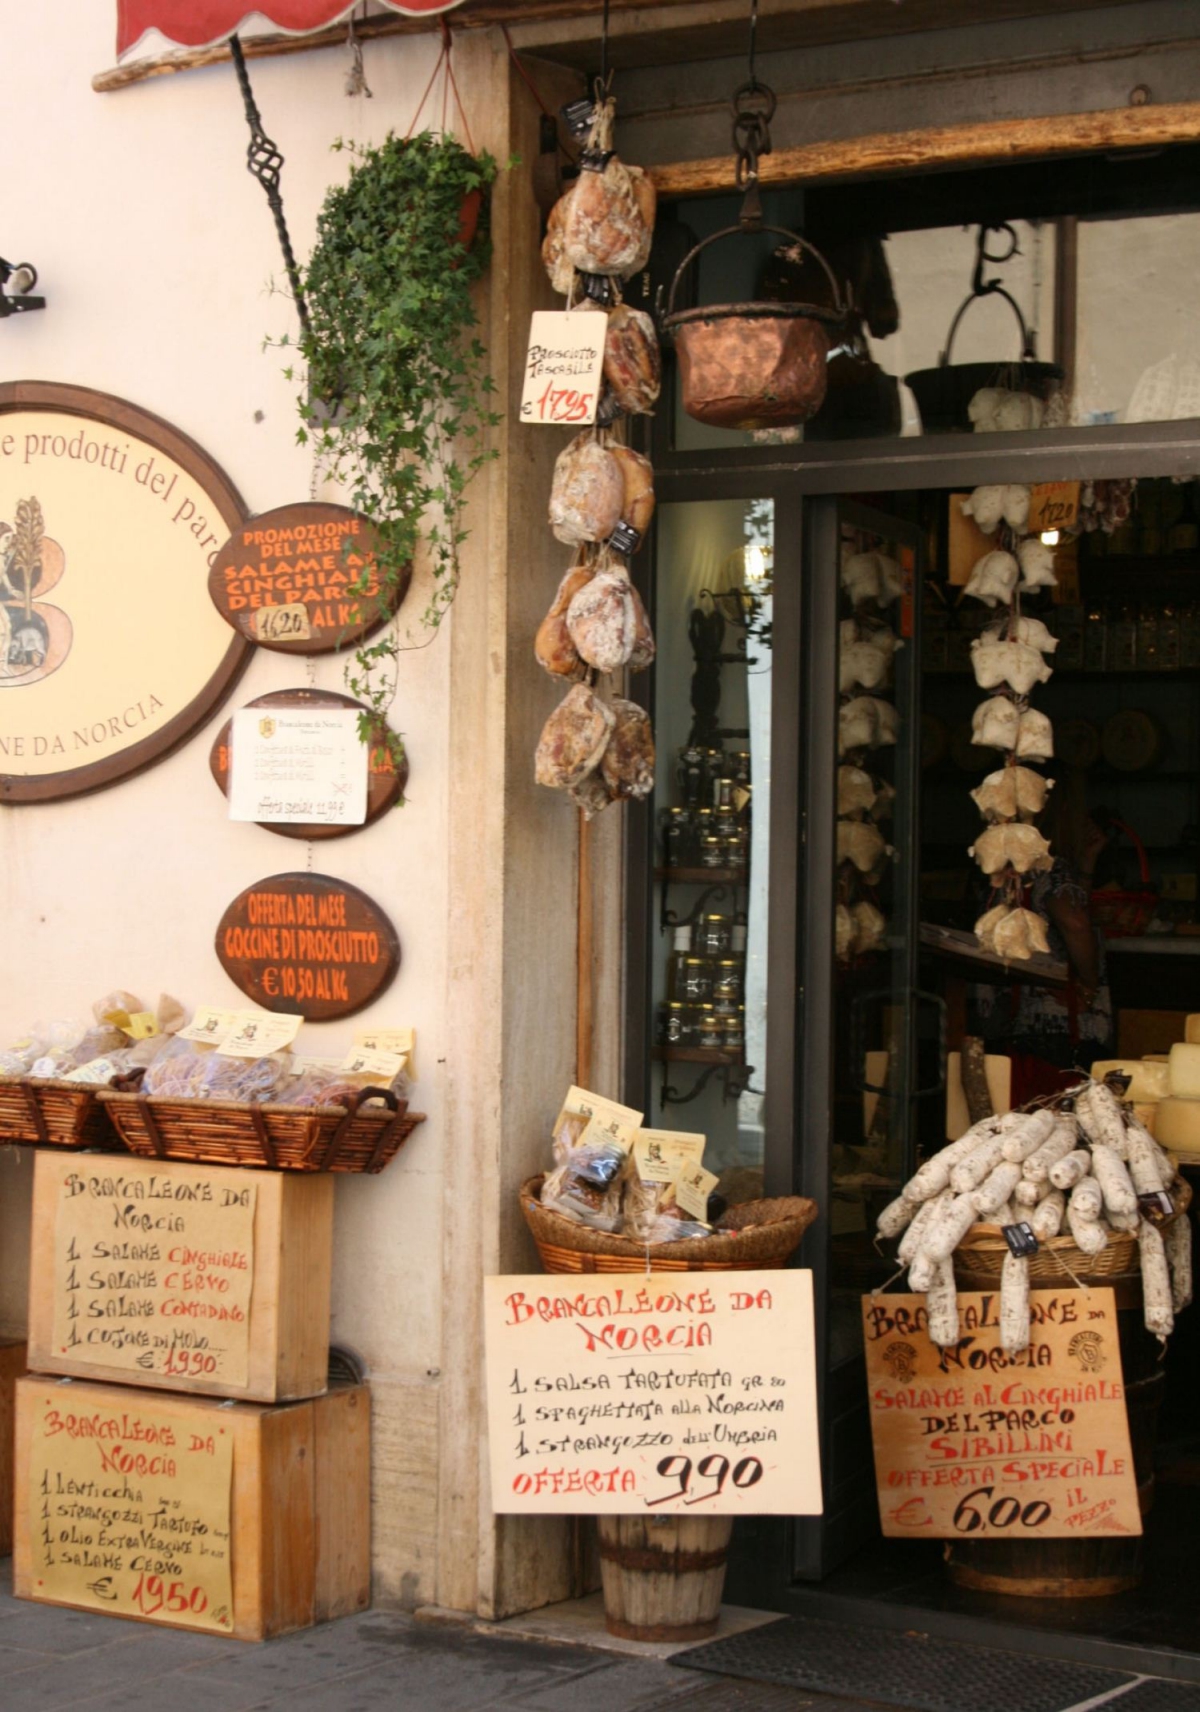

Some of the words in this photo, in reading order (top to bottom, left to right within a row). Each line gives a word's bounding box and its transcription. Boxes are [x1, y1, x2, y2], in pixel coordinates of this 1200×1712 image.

[23, 430, 130, 474] prodotti
[134, 457, 178, 502] del
[243, 519, 360, 546] PROMOZIONE
[261, 543, 293, 559] DEL
[296, 536, 341, 555] MESE
[224, 555, 336, 580] SALAME
[228, 592, 278, 611] DEL
[312, 605, 335, 628] AL
[34, 735, 66, 756] DA
[72, 694, 164, 750] NORCIA
[248, 893, 295, 925] OFFERTA
[296, 894, 317, 926] DEL
[318, 894, 347, 927] MESE
[281, 929, 296, 960] DI
[299, 930, 378, 964] PROSCIUTTO
[316, 970, 331, 1000] AL
[332, 969, 348, 1001] KG
[64, 1174, 213, 1201] BRANCALEONE
[220, 1188, 250, 1208] DA
[113, 1203, 185, 1232] NORCIA
[66, 1237, 80, 1262] 1
[92, 1241, 160, 1261] SALAME
[66, 1265, 80, 1292] 1
[87, 1270, 158, 1290] SALAME
[164, 1272, 230, 1293] CERVO
[67, 1293, 80, 1319] 1
[87, 1296, 155, 1319] SALAME
[505, 1288, 715, 1325] BRANCALEONE
[729, 1289, 772, 1310] DA
[68, 1321, 82, 1347] 1
[576, 1320, 712, 1352] NORCIA
[509, 1368, 527, 1394] 1
[534, 1373, 610, 1392] SALSA
[617, 1367, 732, 1391] TARTUFATA
[874, 1387, 964, 1410] SALAME
[973, 1384, 997, 1406] AL
[1000, 1380, 1123, 1414] CINGHIALE
[512, 1403, 526, 1426] 1
[920, 1412, 980, 1436] DEL
[979, 1408, 1076, 1432] PARCO
[44, 1411, 176, 1446] BRANCALEONE
[188, 1435, 215, 1455] DA
[514, 1430, 530, 1459] 1
[925, 1427, 1073, 1461] SIBILLINI
[97, 1442, 177, 1478] NORCIA
[888, 1464, 994, 1489] OFFERTA
[1002, 1449, 1125, 1483] SPECIALE
[41, 1469, 51, 1495] 1
[512, 1466, 636, 1496] OFFERTA
[41, 1497, 50, 1519] 1
[42, 1520, 54, 1546] 1
[44, 1546, 55, 1567] 1
[61, 1551, 122, 1570] SALAME
[130, 1556, 182, 1575] CERVO
